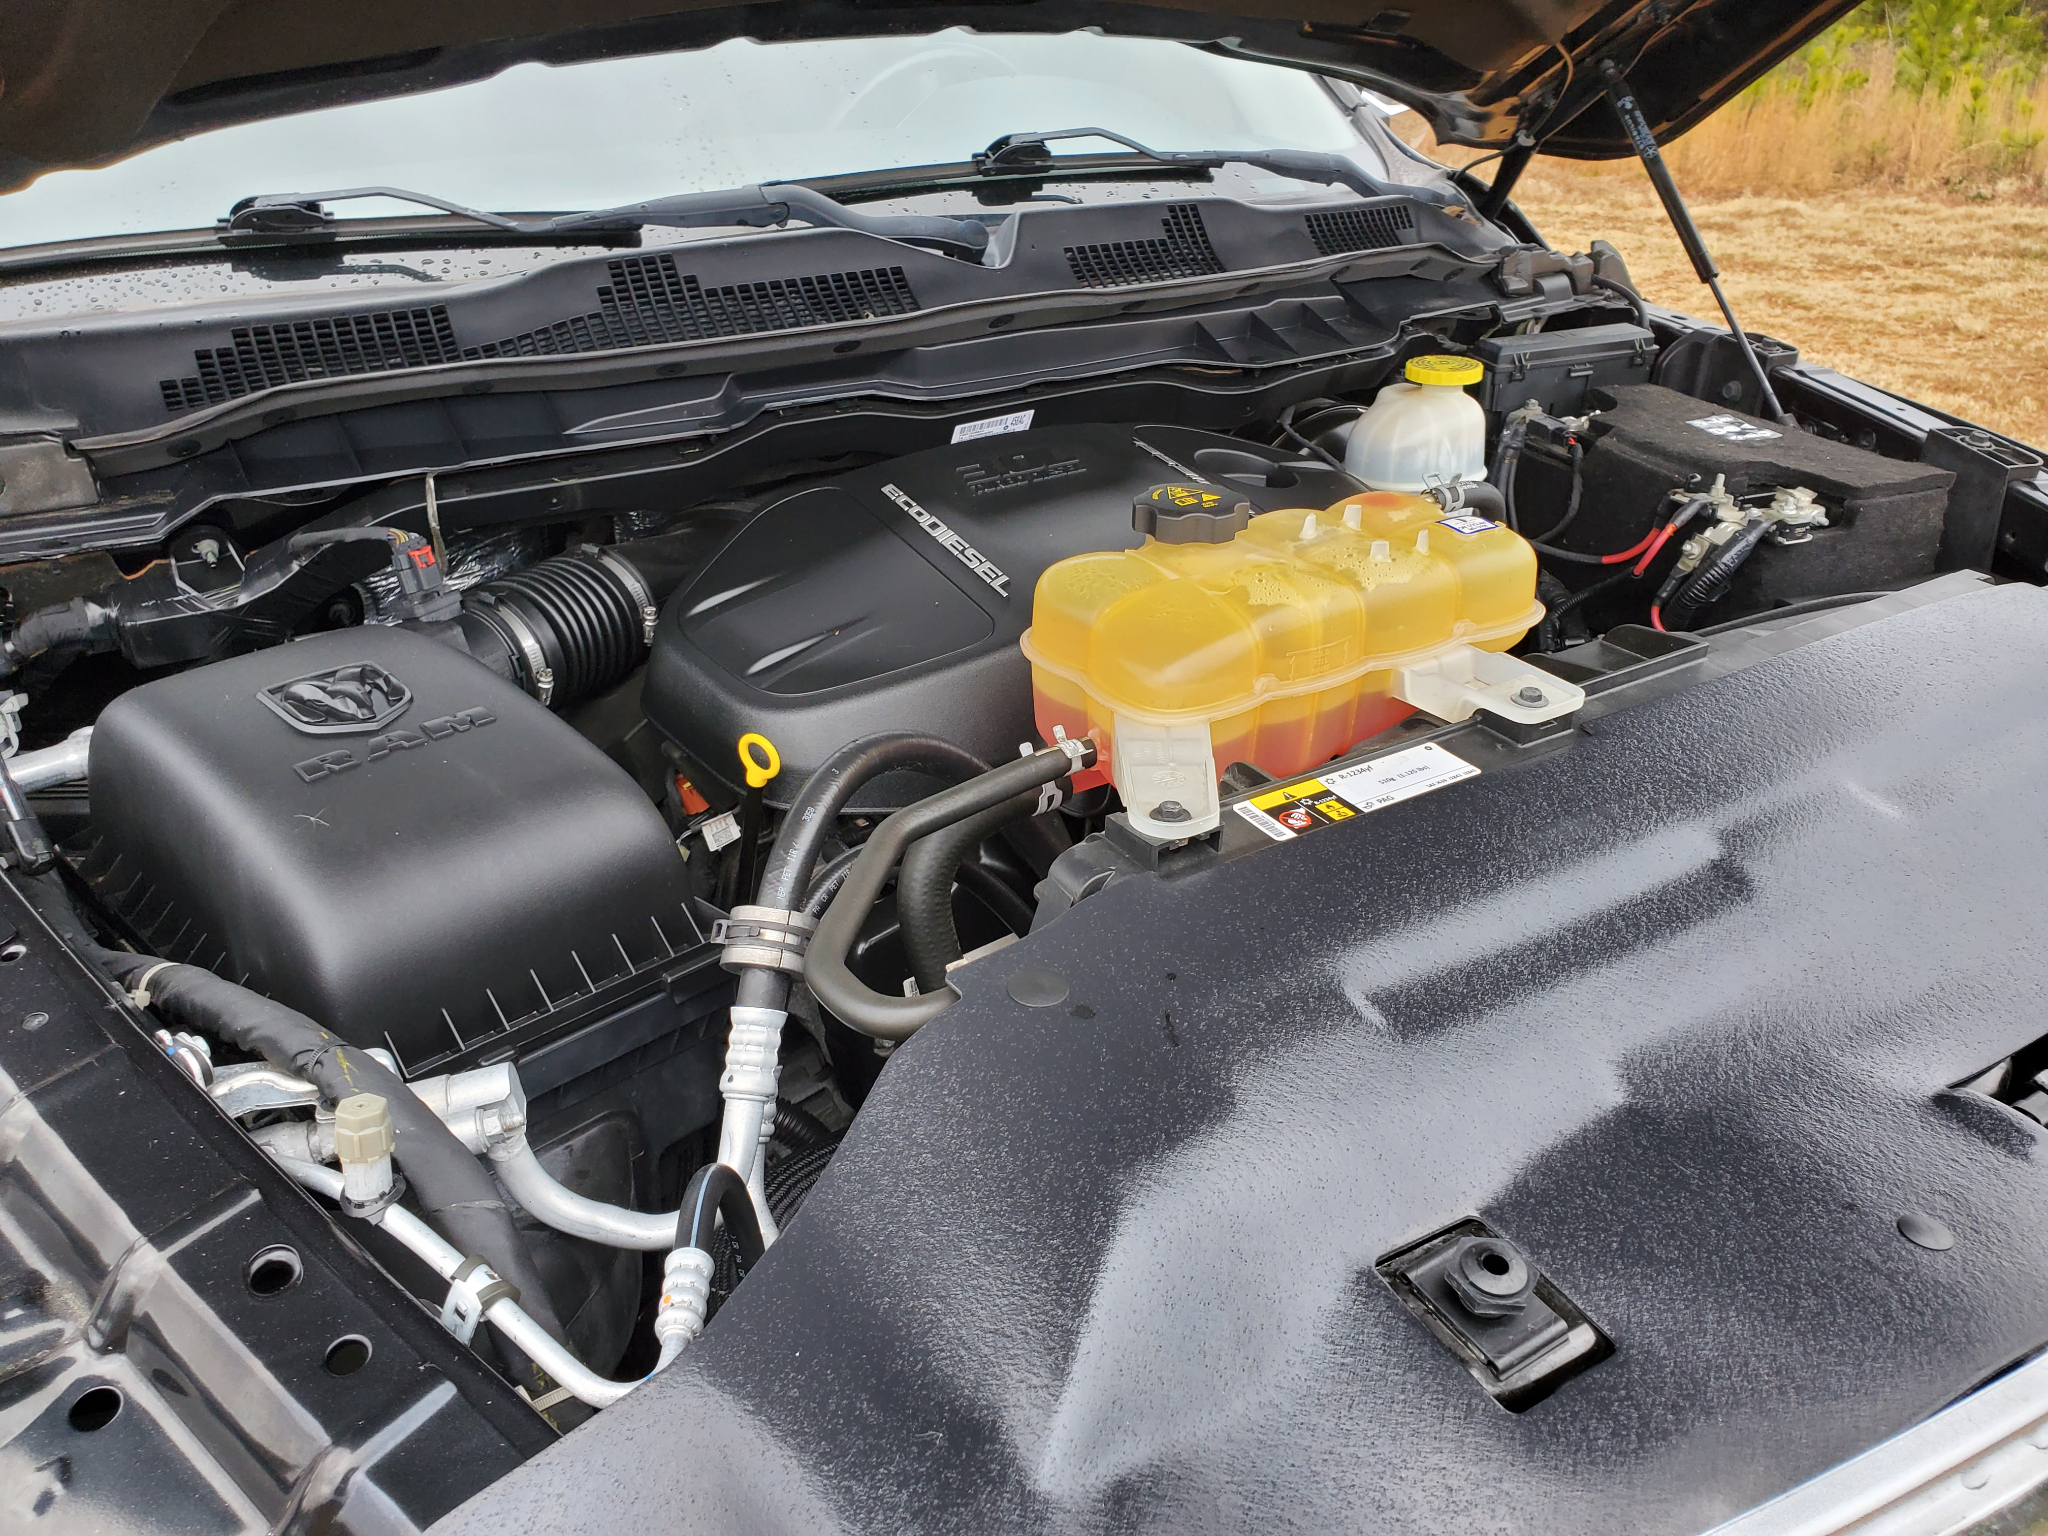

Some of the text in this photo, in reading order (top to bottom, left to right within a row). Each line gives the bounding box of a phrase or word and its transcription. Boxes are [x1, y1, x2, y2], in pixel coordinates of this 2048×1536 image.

[880, 483, 1011, 598] ECODIESEL
[292, 706, 497, 783] RAM
[1338, 764, 1374, 780] R-1234yf
[1376, 795, 1395, 804] PAG
[782, 867, 792, 881] PET
[829, 880, 840, 892] PET
